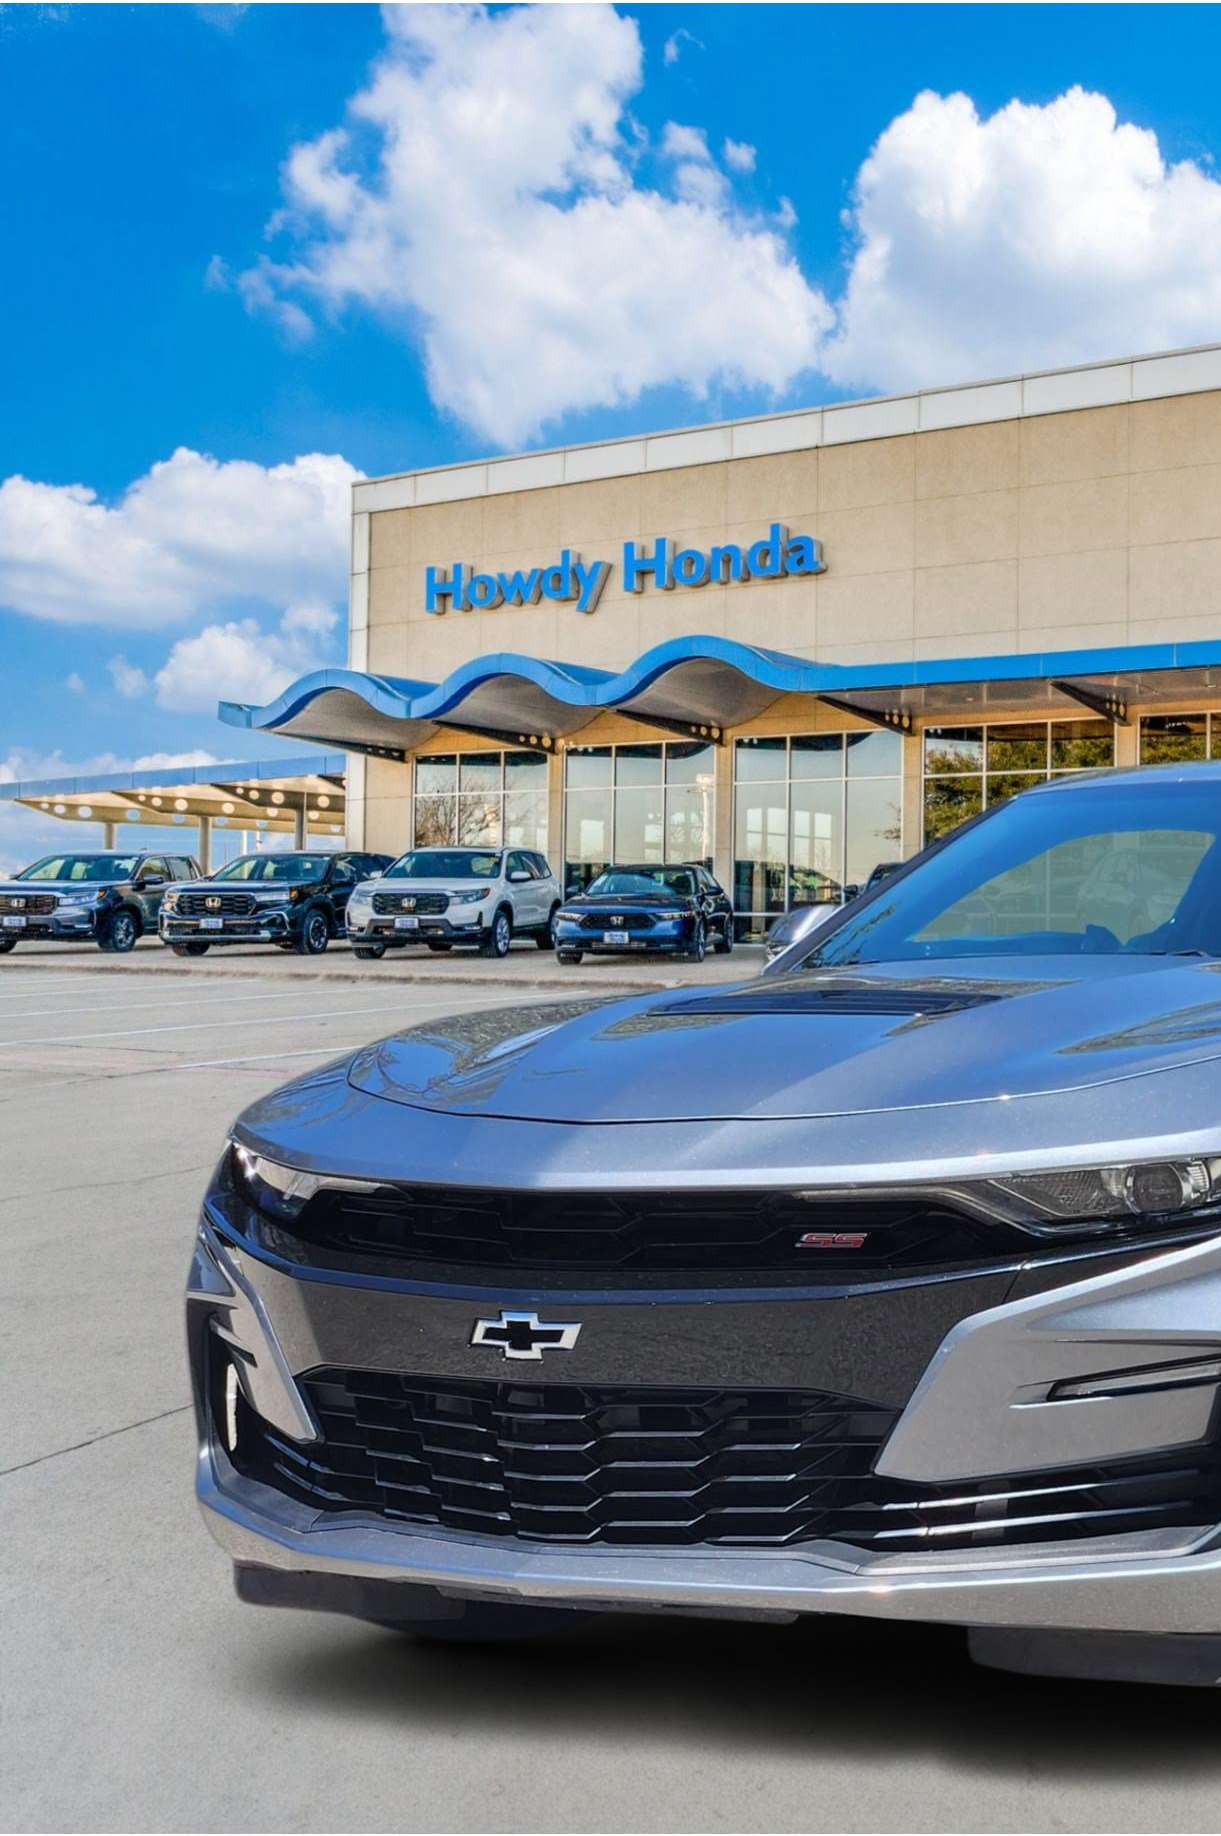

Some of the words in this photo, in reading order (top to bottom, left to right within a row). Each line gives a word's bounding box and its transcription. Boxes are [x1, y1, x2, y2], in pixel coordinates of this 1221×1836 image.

[425, 549, 611, 613] Howdy
[623, 523, 823, 593] Honda
[794, 1232, 868, 1249] SS
